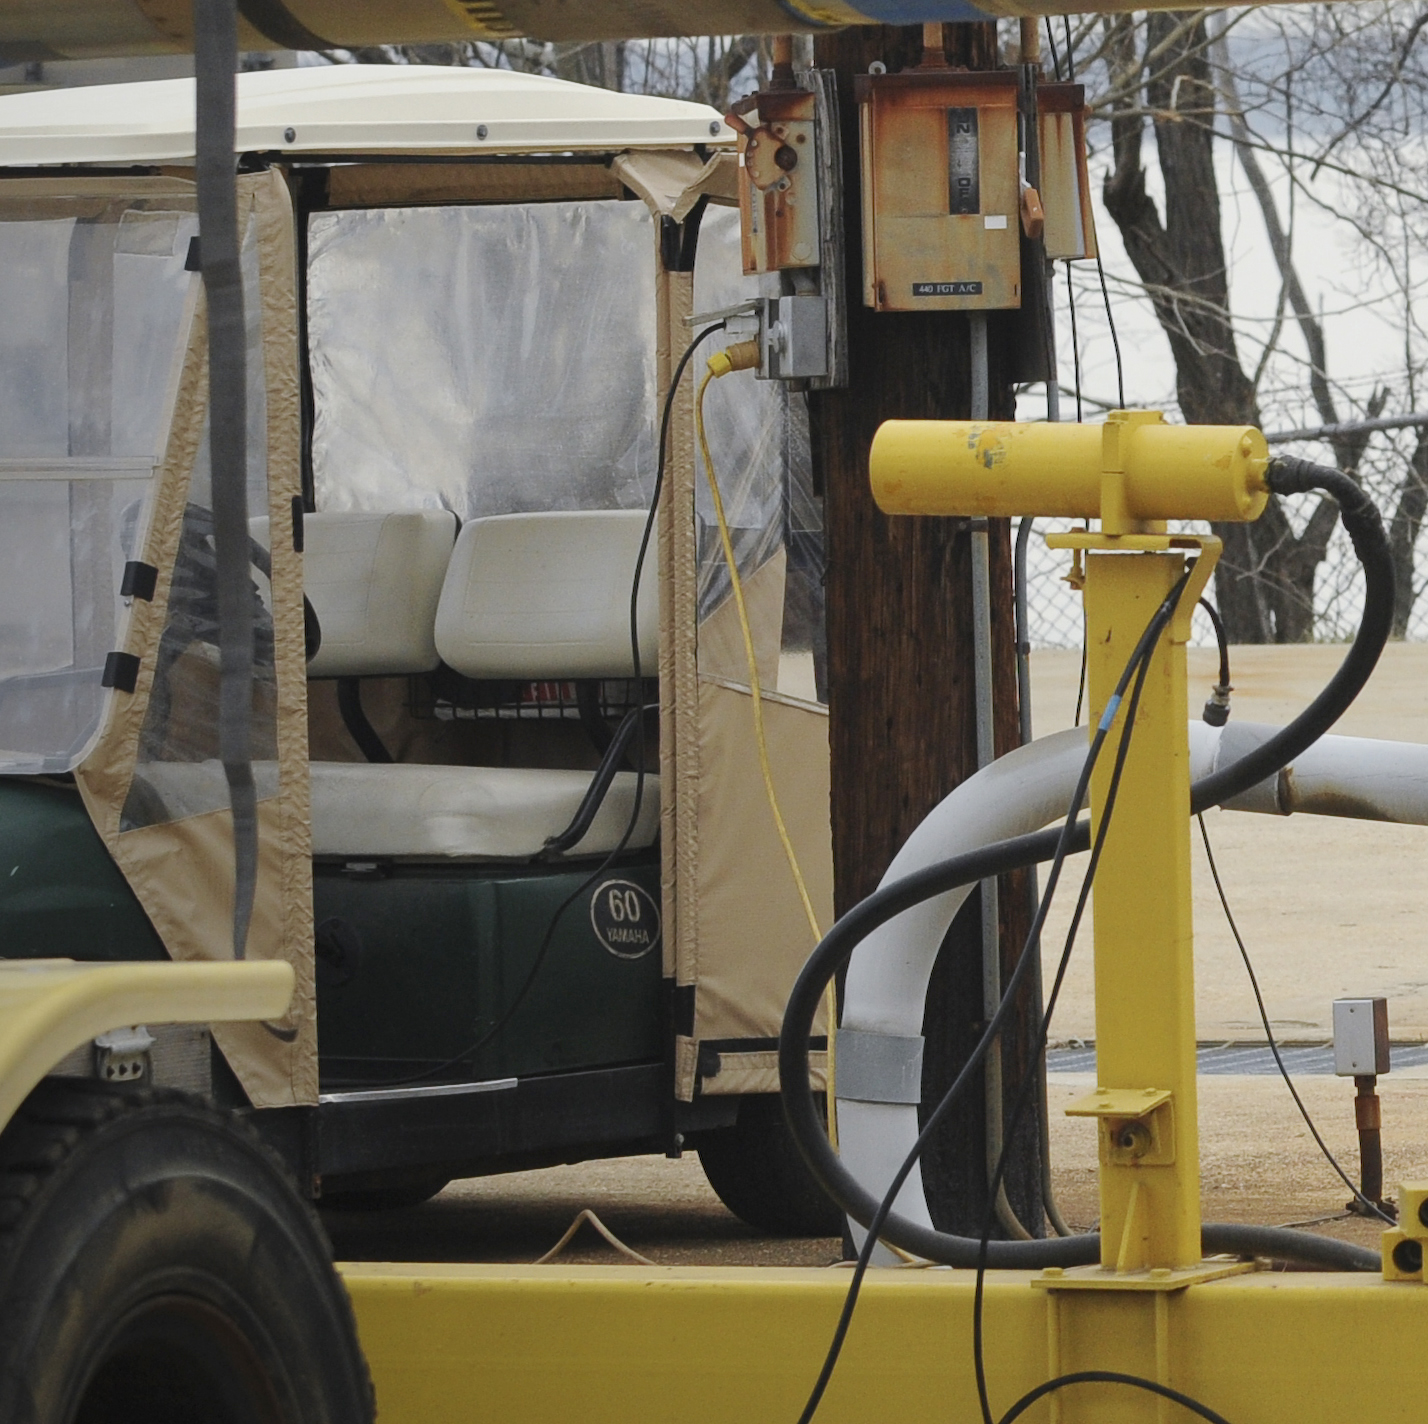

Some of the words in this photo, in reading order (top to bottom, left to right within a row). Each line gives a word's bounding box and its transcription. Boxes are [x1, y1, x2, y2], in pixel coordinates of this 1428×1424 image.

[919, 284, 934, 293] 440
[959, 283, 977, 293] A/C
[608, 889, 641, 922] 60
[606, 927, 650, 944] YAMAHA
